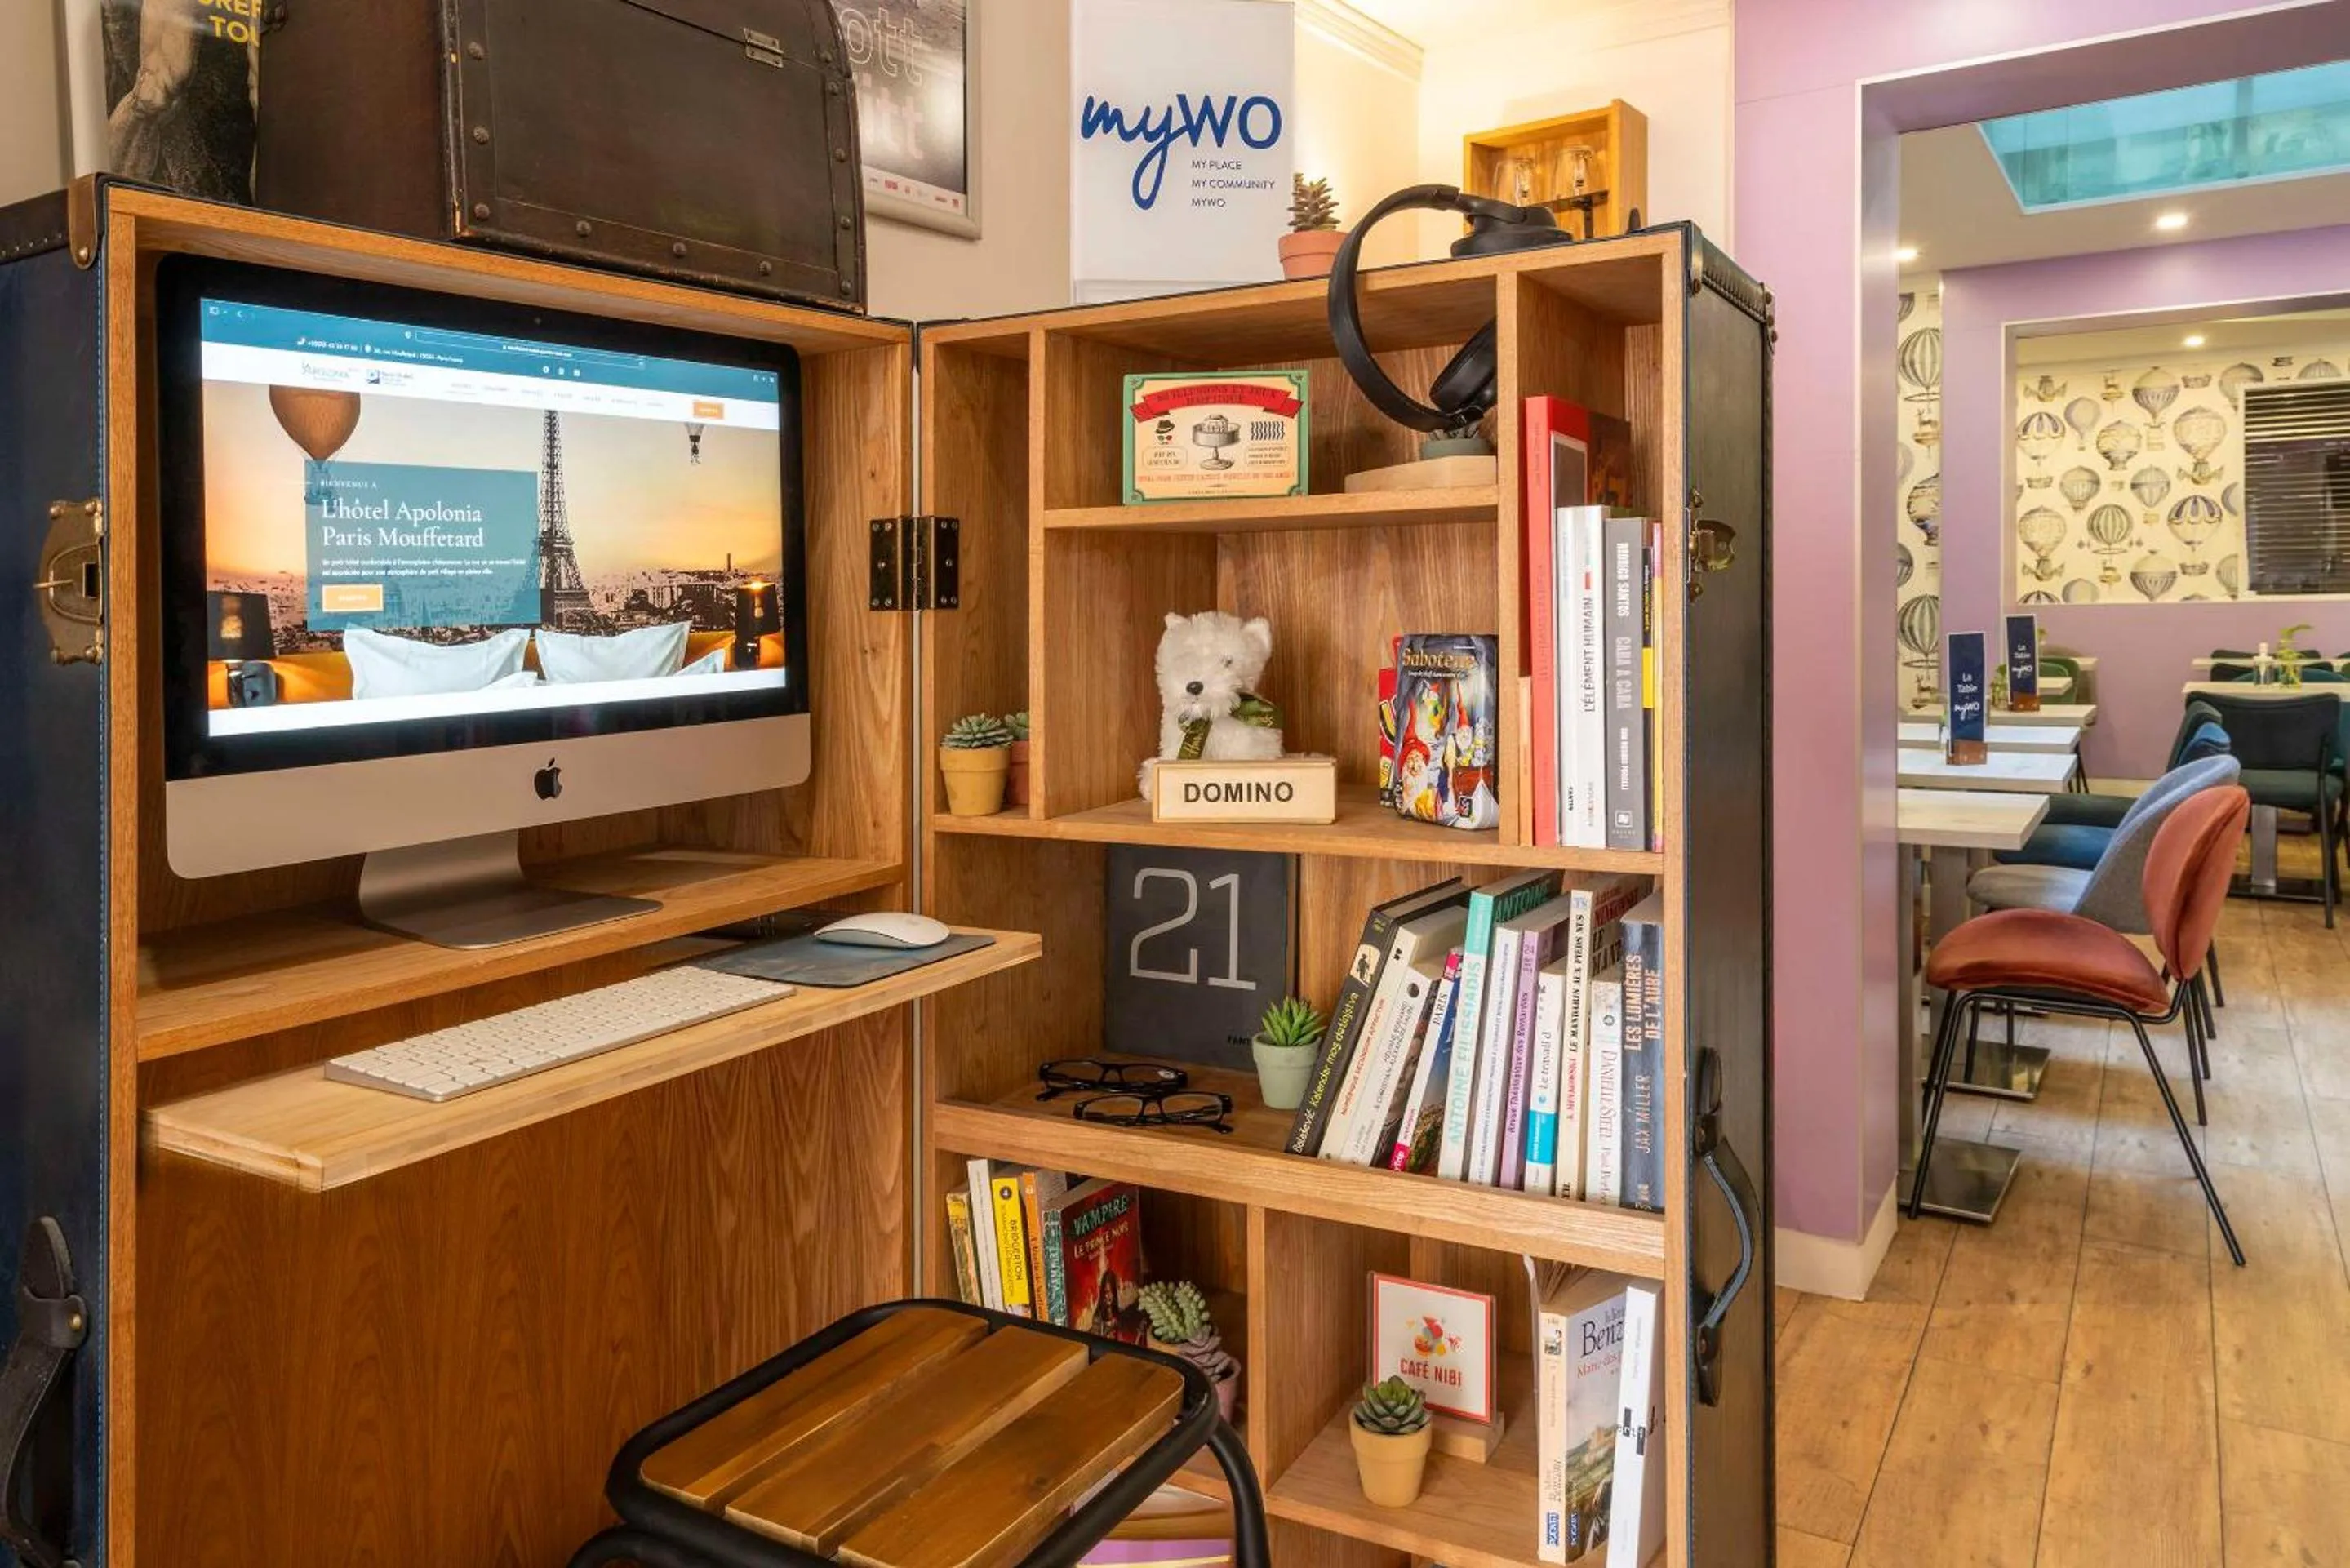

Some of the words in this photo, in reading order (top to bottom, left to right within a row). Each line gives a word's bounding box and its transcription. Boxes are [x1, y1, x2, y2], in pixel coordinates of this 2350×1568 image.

[1081, 93, 1282, 211] myWO
[1191, 160, 1207, 170] MY
[1209, 160, 1242, 170] PLACE
[1191, 179, 1207, 189] MY
[1209, 179, 1275, 189] COMMUNITY
[1191, 198, 1226, 207] MYWO
[322, 497, 389, 520] L'hôtel
[395, 500, 482, 528] Apolonia
[322, 526, 372, 547] Paris
[378, 525, 485, 548] Mouffetard
[1617, 582, 1630, 617] SANTOS
[1582, 597, 1595, 646] HUMAIN
[1580, 650, 1595, 713] L'ÉLÉMENT
[1957, 683, 1978, 693] Table
[1962, 672, 1972, 682] La
[1954, 701, 1980, 721] myWO
[1184, 781, 1294, 803] DOMINO
[1130, 867, 1257, 990] 21
[1574, 937, 1584, 965] PIEDS
[1623, 954, 1642, 1022] LUMIÈRES
[1643, 969, 1662, 1018] L'AUBE
[1432, 992, 1448, 1026] PARIS
[1624, 1025, 1642, 1051] LES
[1644, 1020, 1662, 1039] DE
[1570, 1042, 1579, 1054] LE
[1600, 1050, 1618, 1107] DANIELLE
[1448, 1065, 1470, 1144] ANTOINE
[1634, 1074, 1652, 1123] MILLER
[1634, 1129, 1651, 1154] JAX
[1073, 1195, 1129, 1237] VAMPIRE
[1074, 1244, 1085, 1259] LE
[1400, 1357, 1428, 1379] CAFÉ
[1434, 1366, 1462, 1386] NIBI
